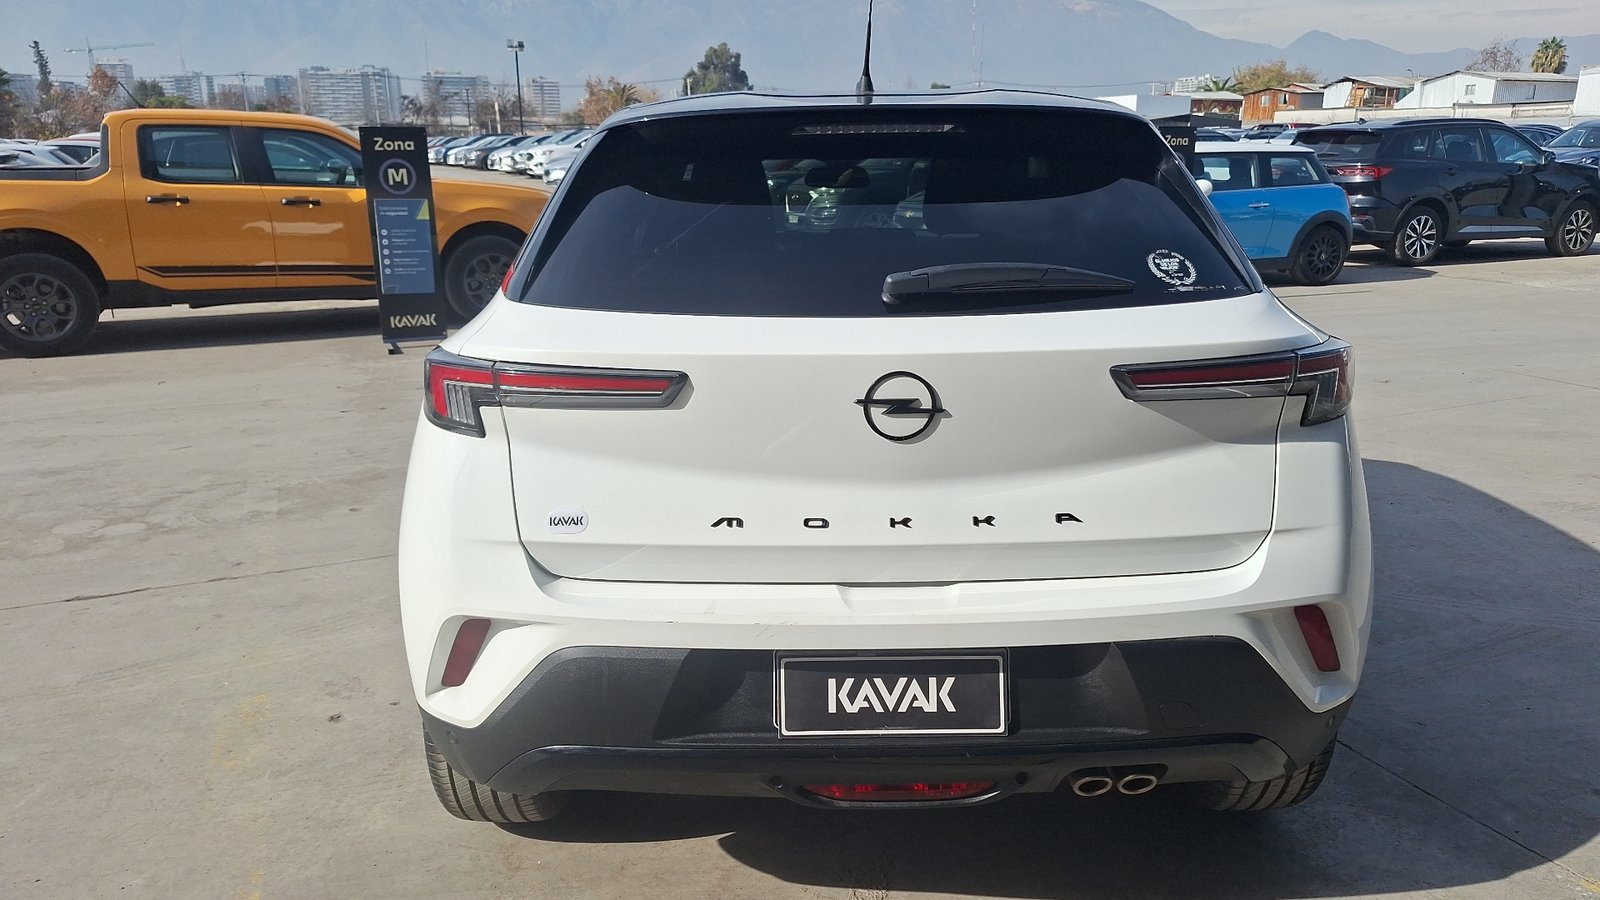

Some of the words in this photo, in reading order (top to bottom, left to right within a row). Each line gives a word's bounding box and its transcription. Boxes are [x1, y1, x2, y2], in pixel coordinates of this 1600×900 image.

[373, 137, 414, 151] Zona
[1165, 135, 1189, 146] Zona
[387, 168, 408, 186] M
[390, 313, 437, 328] KAVAK
[549, 515, 584, 527] KAVAK
[710, 512, 1084, 529] MOKKA
[828, 676, 957, 714] KAVAK
